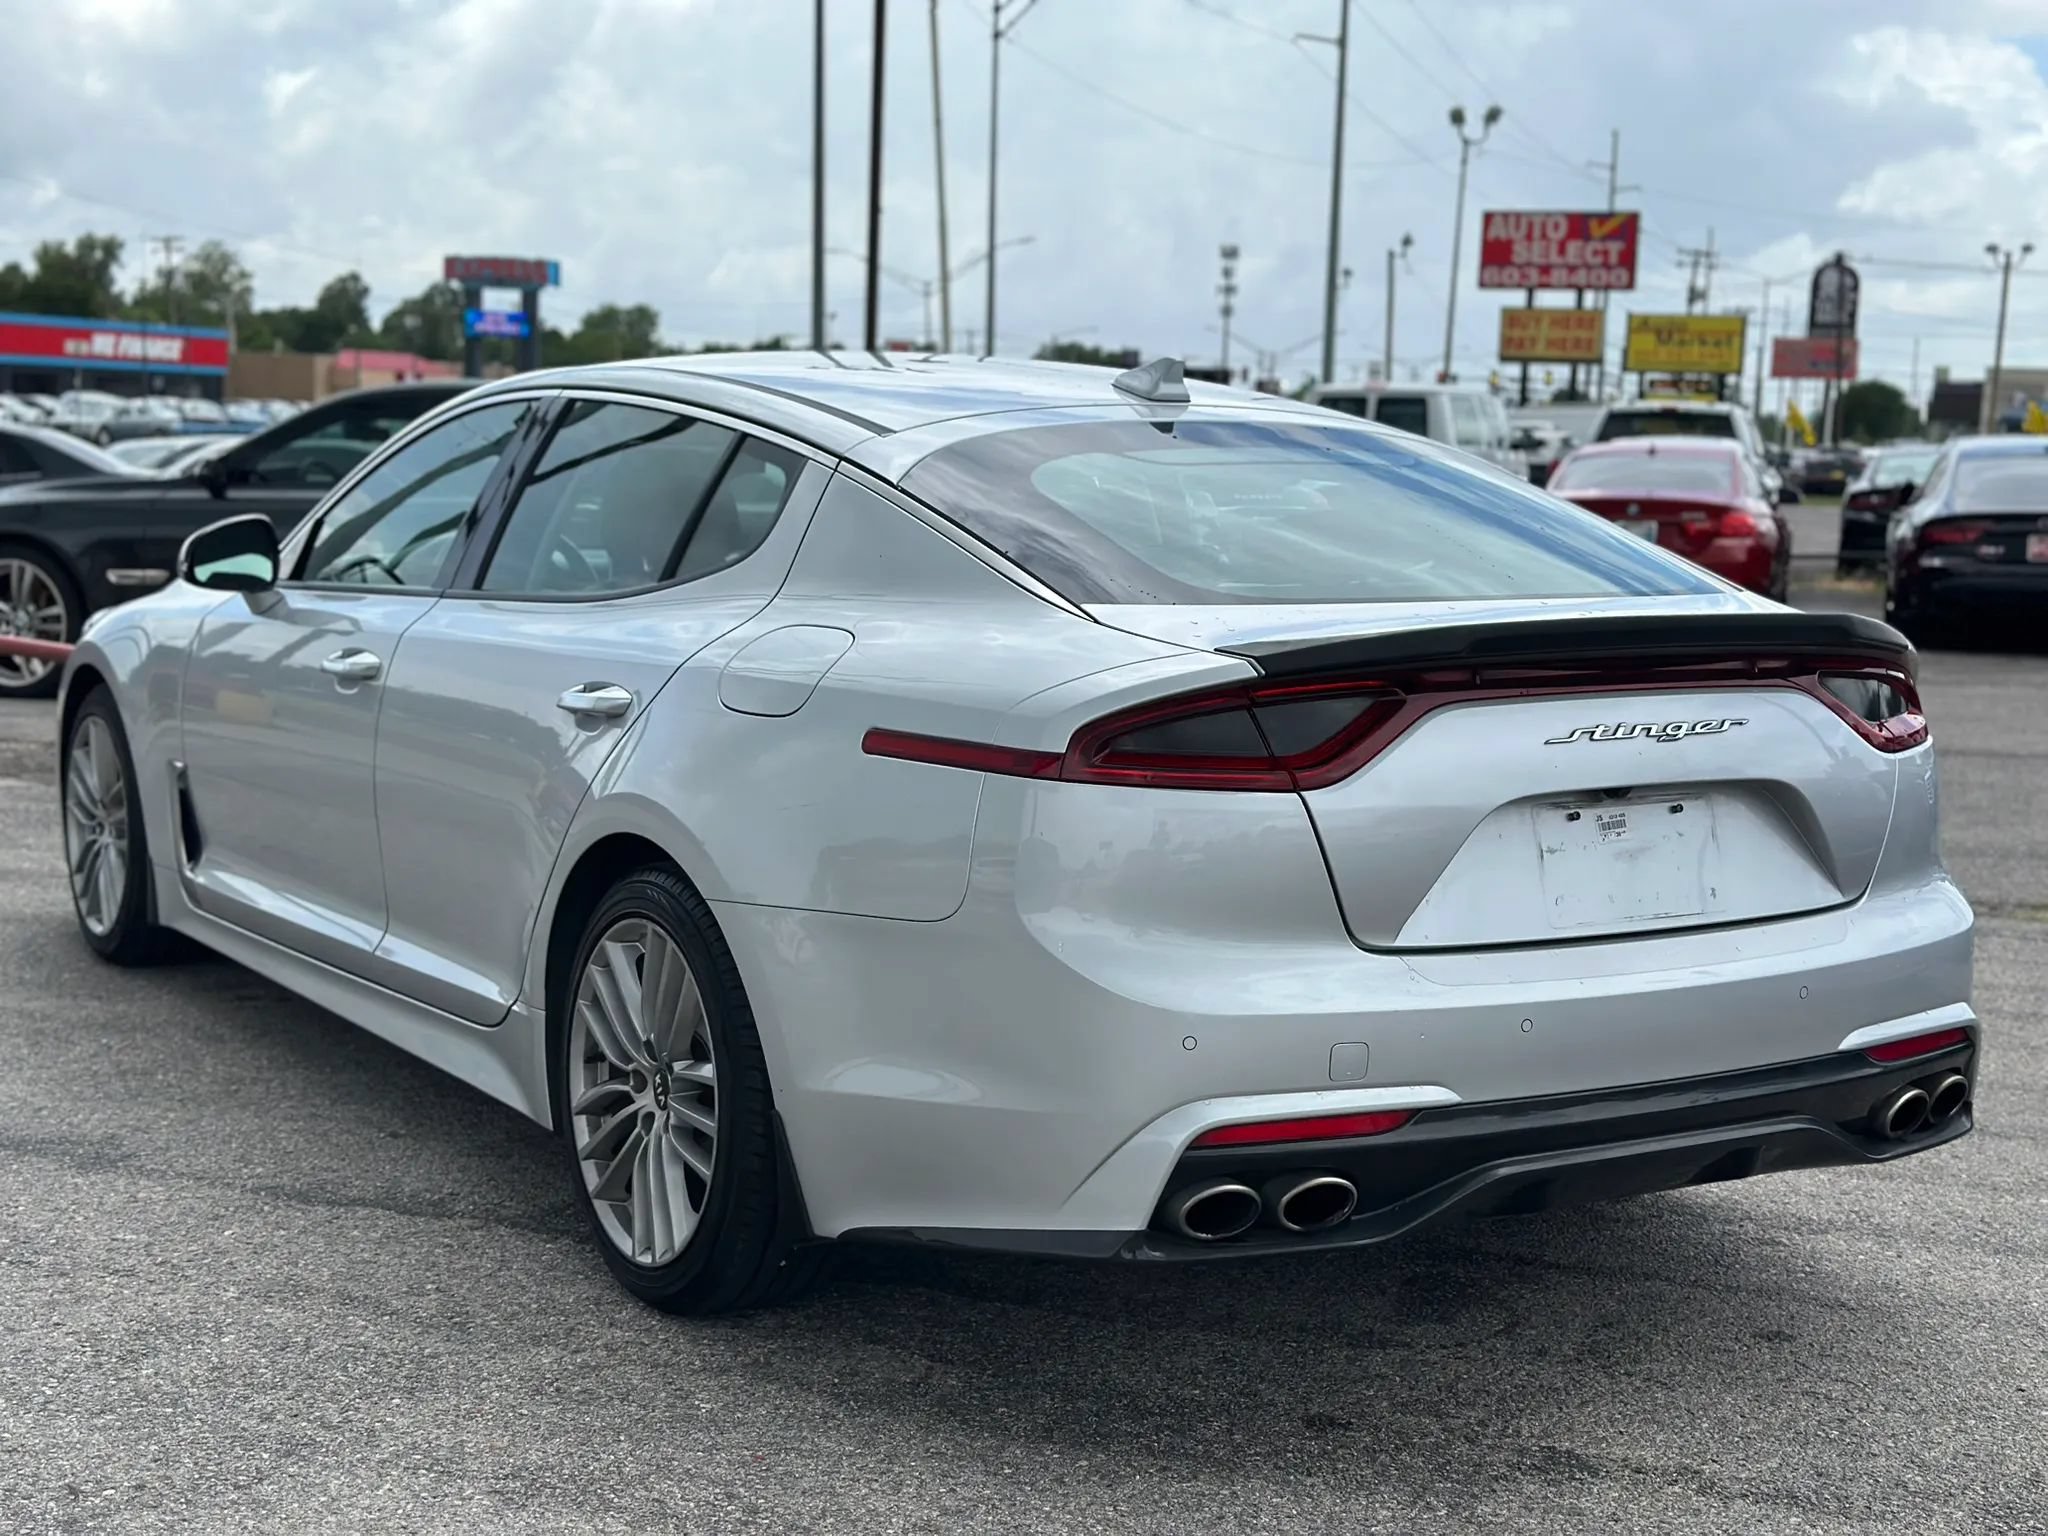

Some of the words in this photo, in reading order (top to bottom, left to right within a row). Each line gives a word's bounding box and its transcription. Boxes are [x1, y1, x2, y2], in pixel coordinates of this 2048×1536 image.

[1485, 213, 1568, 242] AUTO
[1511, 239, 1626, 265] SELECT
[1549, 312, 1598, 332] HERE
[1545, 335, 1597, 354] HERE
[655, 1072, 665, 1107] KIA
